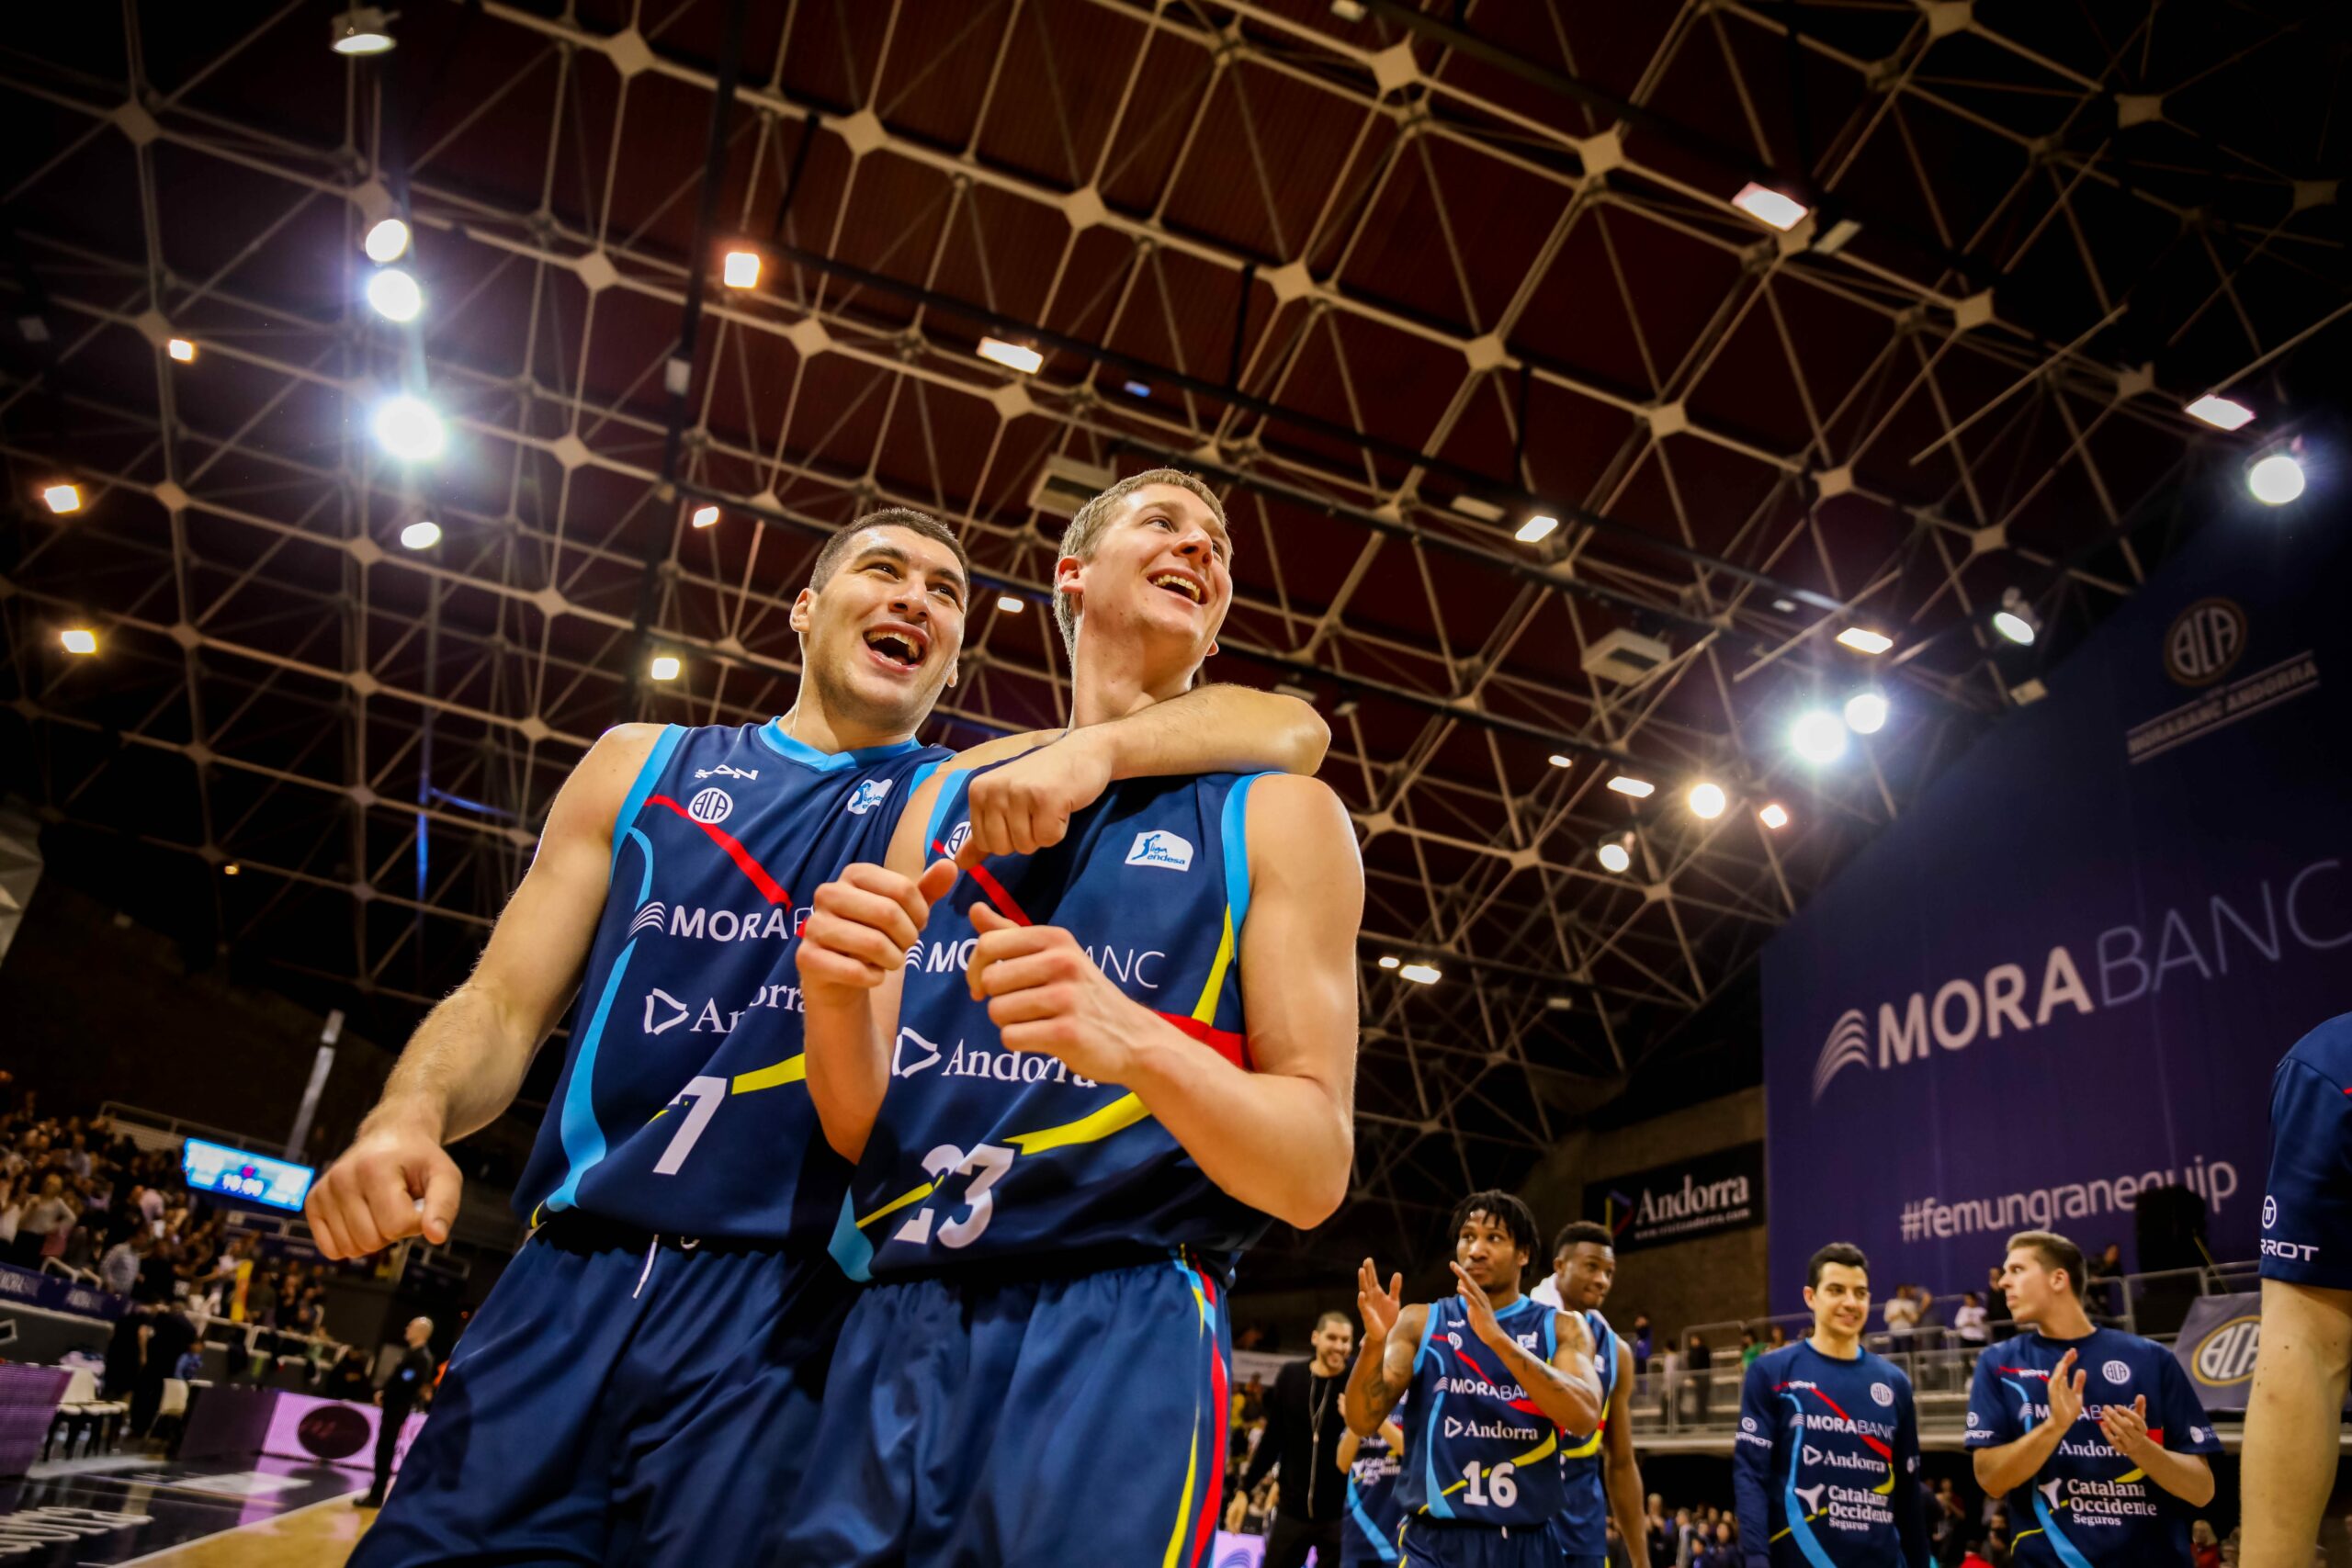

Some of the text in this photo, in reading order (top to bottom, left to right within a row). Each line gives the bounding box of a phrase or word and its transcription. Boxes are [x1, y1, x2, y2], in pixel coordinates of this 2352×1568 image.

[1147, 854, 1185, 864] endesa
[1879, 859, 2352, 1070] MORABANC
[652, 1076, 728, 1175] 7
[893, 1144, 1015, 1249] 23
[1635, 1174, 1748, 1225] Andorra
[1449, 1378, 1529, 1403] MORABA
[1464, 1420, 1538, 1440] Andorra
[1823, 1450, 1885, 1473] Andorra
[1462, 1460, 1518, 1508] 16
[2067, 1479, 2146, 1497] Catalana
[2070, 1496, 2157, 1516] Occidente
[1828, 1517, 1870, 1531] Seguros
[2073, 1513, 2121, 1526] Seguros
